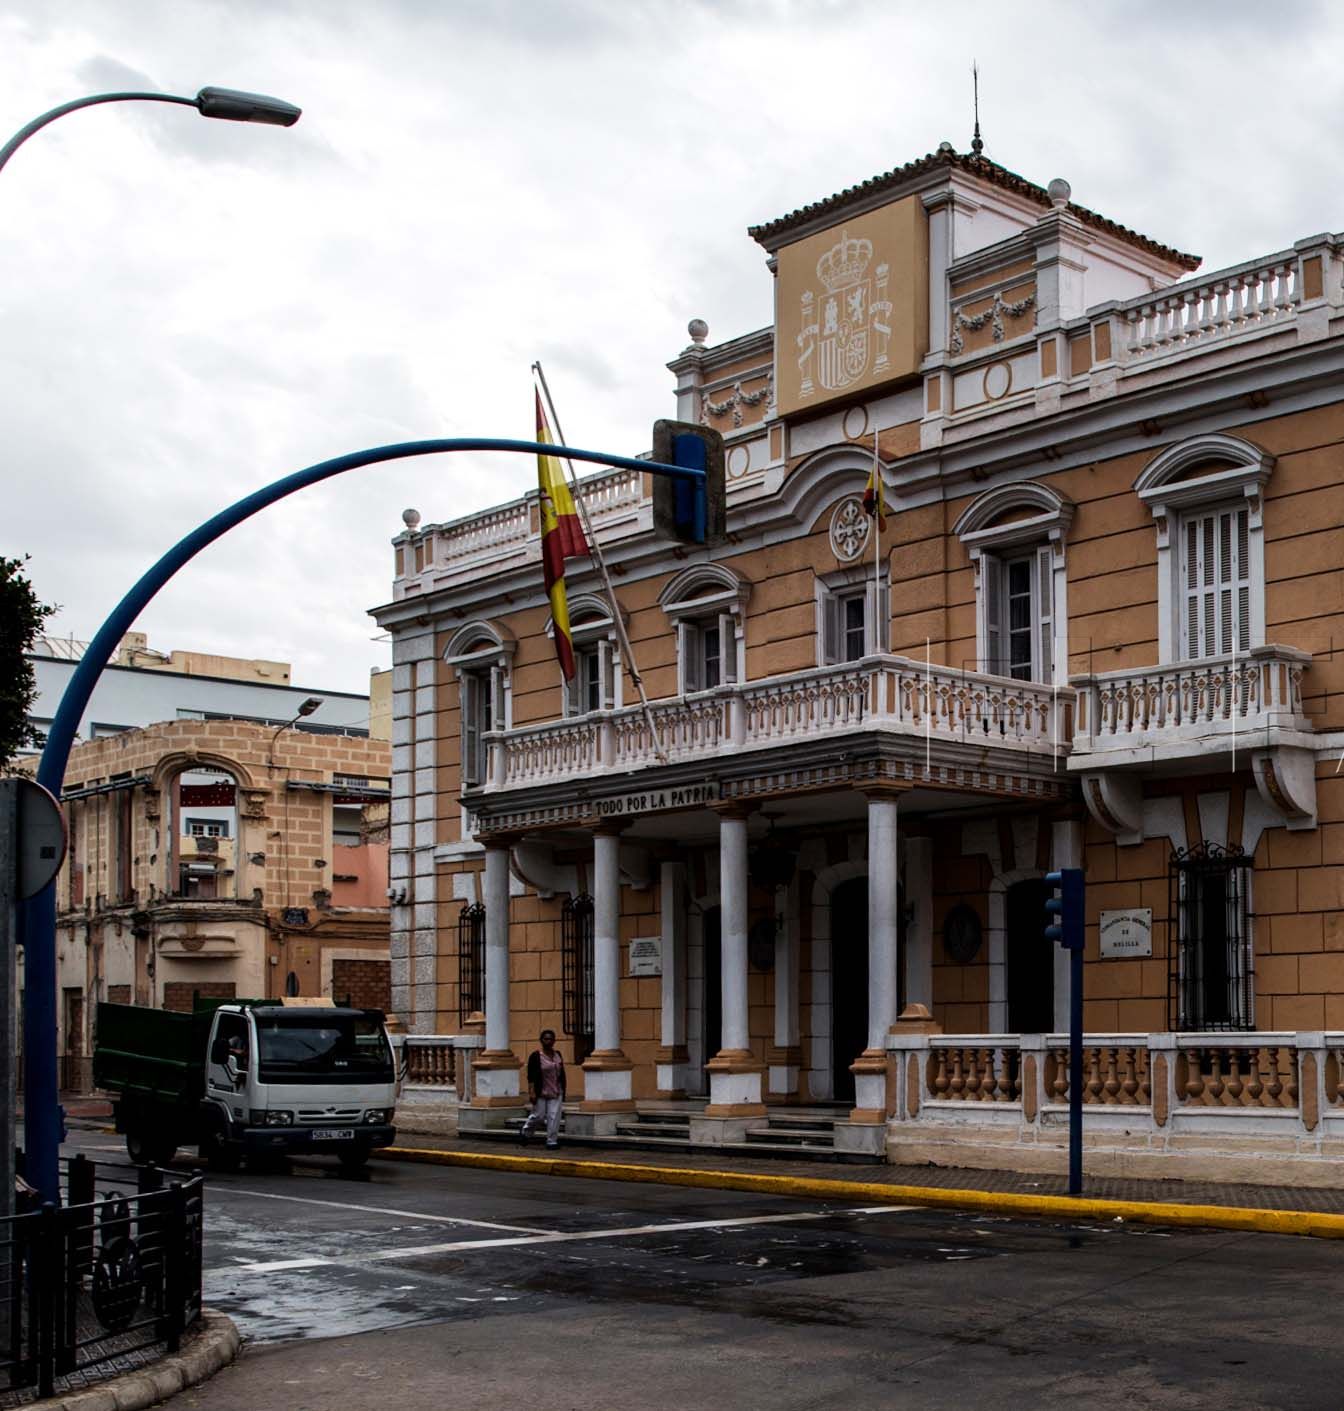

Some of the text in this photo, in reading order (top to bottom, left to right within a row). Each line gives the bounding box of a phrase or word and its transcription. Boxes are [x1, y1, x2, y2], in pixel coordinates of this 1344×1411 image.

[596, 786, 714, 815] TODO POR LA PATRIA
